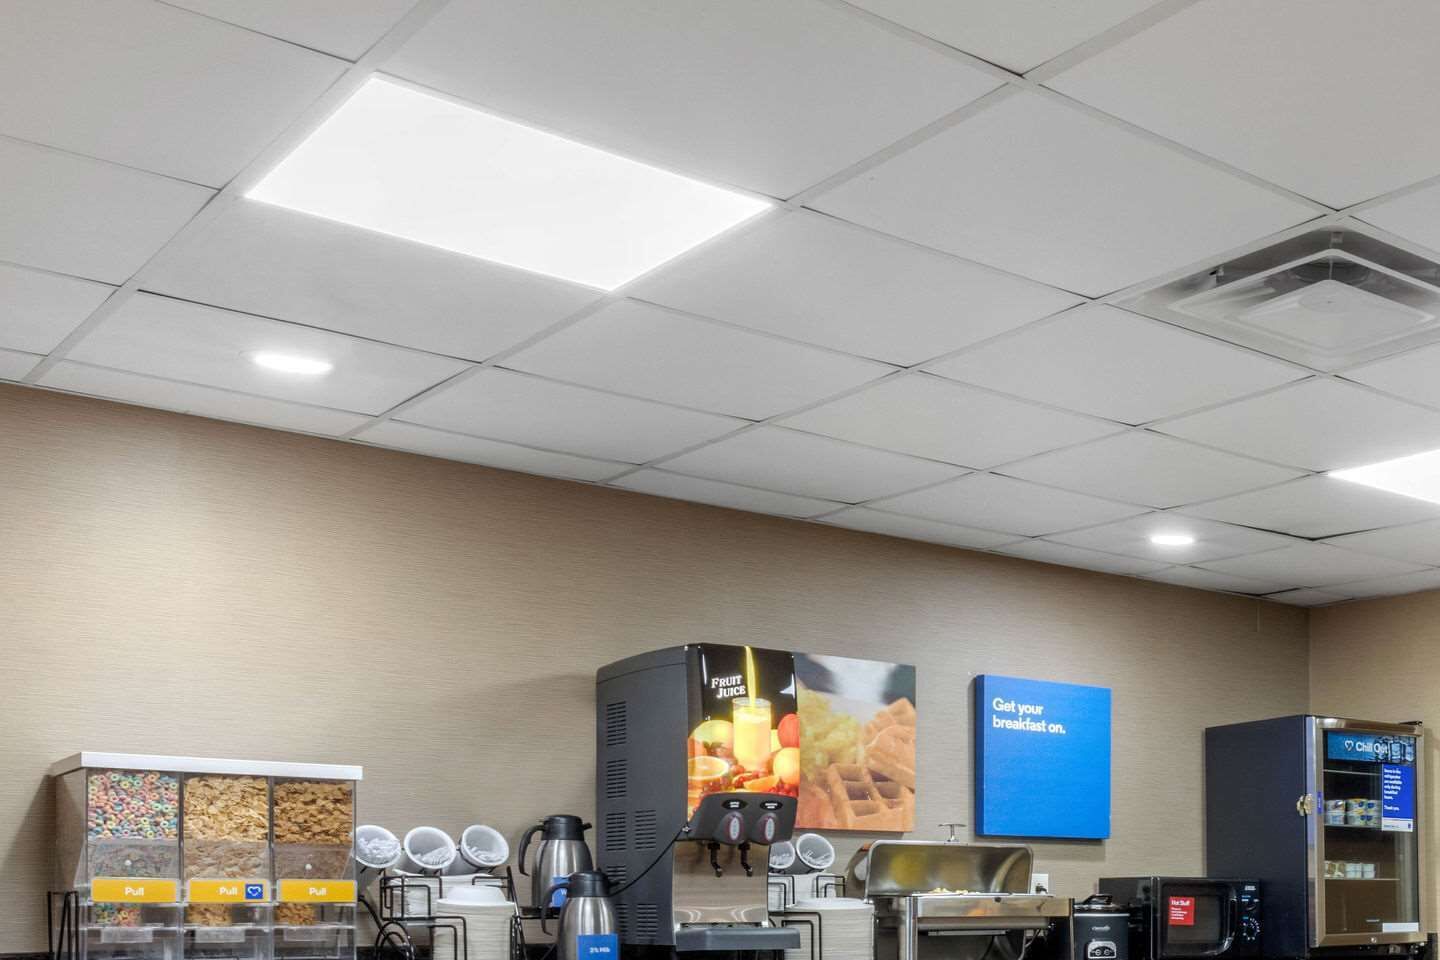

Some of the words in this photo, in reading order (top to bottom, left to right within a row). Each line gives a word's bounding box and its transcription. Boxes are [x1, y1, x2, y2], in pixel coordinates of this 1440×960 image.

[711, 674, 743, 689] FRUIT
[716, 685, 747, 699] JUICE
[992, 697, 1016, 713] Get
[1017, 703, 1044, 716] your
[992, 714, 1047, 733] breakfast
[1048, 722, 1067, 735] on.
[1355, 741, 1372, 752] Chill
[124, 886, 145, 897] Pull
[219, 886, 238, 897] Pull
[308, 886, 327, 897] Pull
